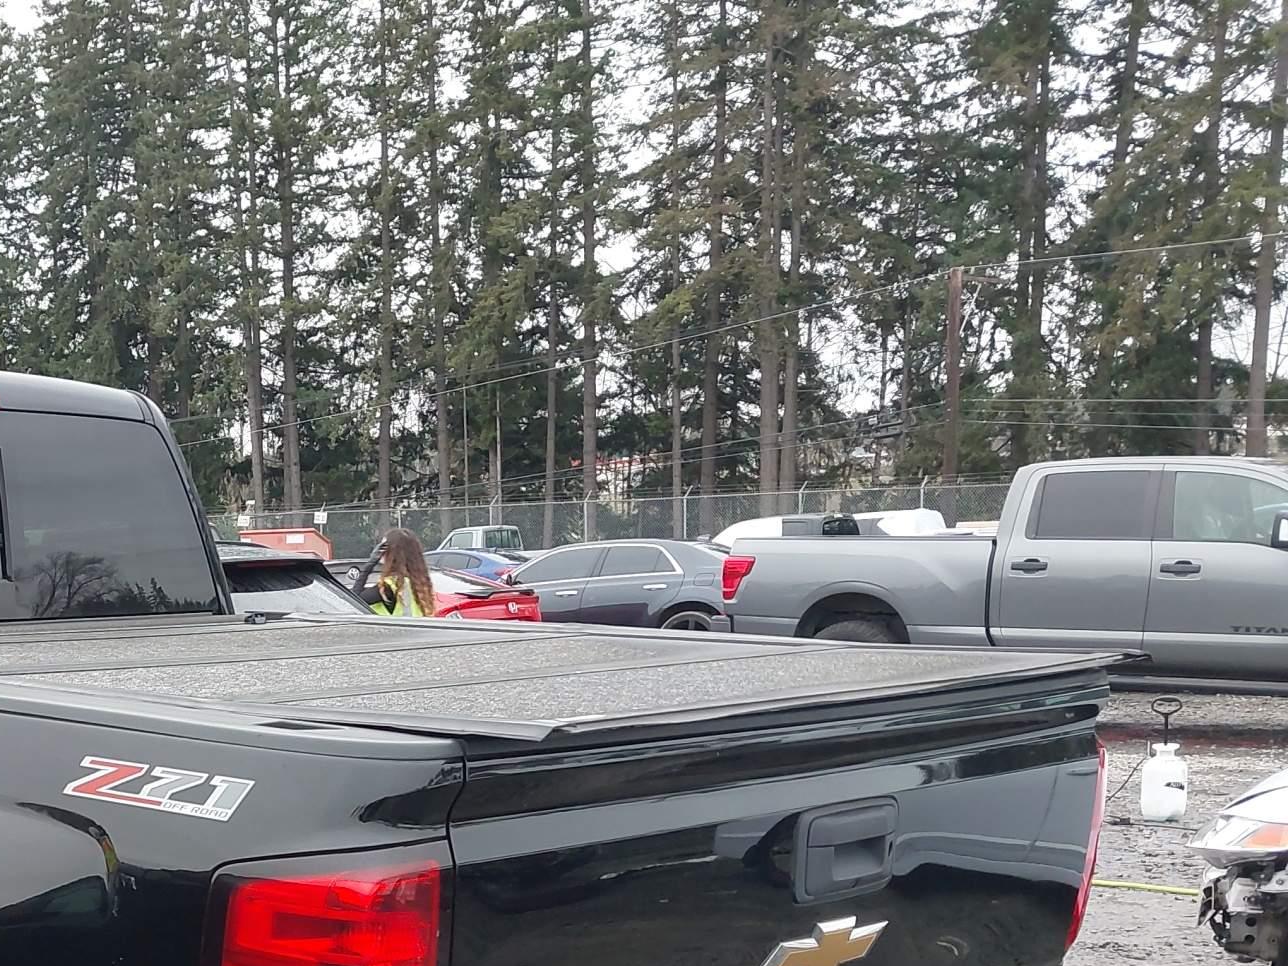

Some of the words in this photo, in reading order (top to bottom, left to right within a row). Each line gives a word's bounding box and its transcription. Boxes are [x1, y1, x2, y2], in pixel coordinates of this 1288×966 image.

[63, 756, 256, 814] Z71
[162, 801, 189, 812] OFF
[190, 806, 230, 818] ROAD
